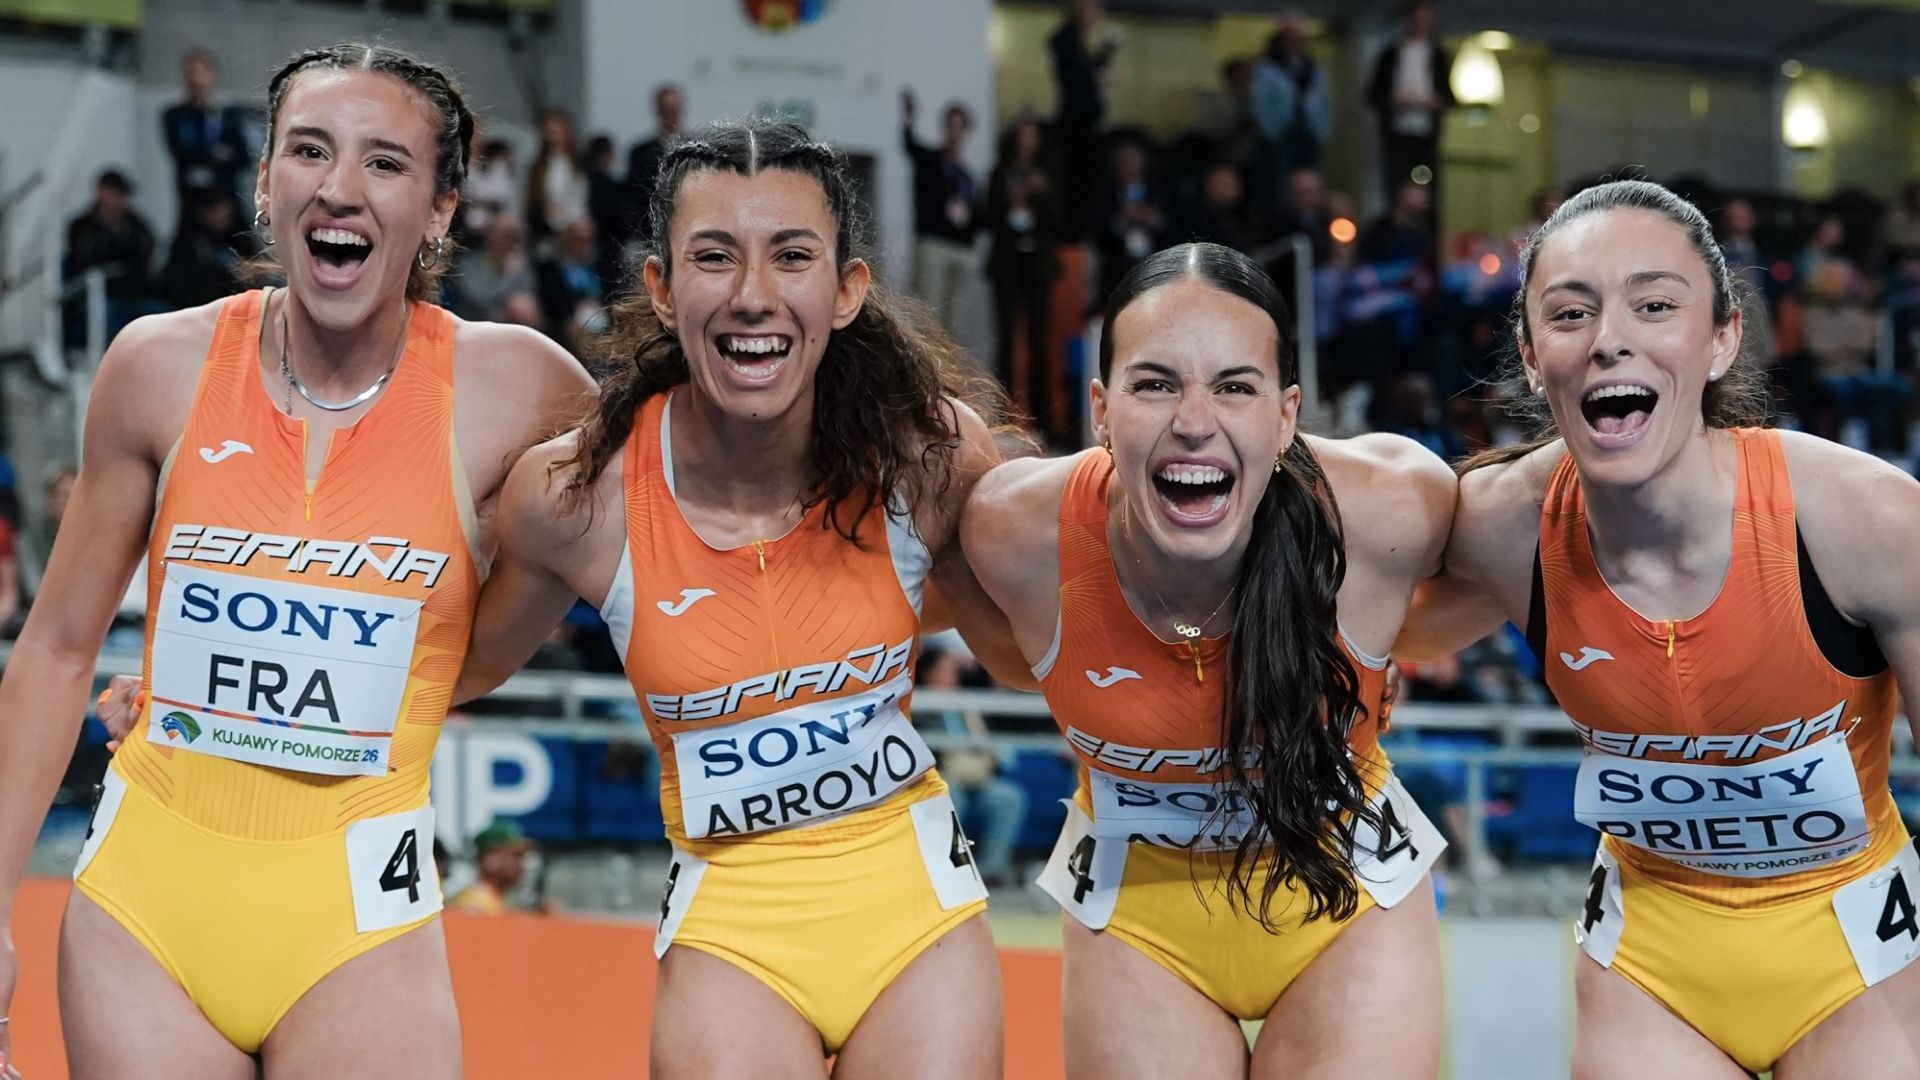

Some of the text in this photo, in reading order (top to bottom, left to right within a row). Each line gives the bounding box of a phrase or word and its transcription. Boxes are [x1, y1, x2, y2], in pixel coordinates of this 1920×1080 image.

[163, 524, 450, 588] ESPAÑA
[181, 582, 394, 647] SONY
[207, 653, 341, 724] FRA
[646, 635, 914, 721] ESPAÑA
[212, 728, 278, 750] KUJAWY
[281, 740, 361, 762] POMORZE
[1065, 724, 1265, 775] ESPA
[703, 734, 917, 838] ARROYO
[1598, 757, 1824, 804] SONY
[1596, 810, 1846, 851] PRIETO
[1744, 851, 1833, 871] POMORZE
[379, 828, 420, 904] 4
[1067, 834, 1097, 905] 4
[1582, 862, 1608, 934] 4
[1876, 867, 1920, 943] 4
